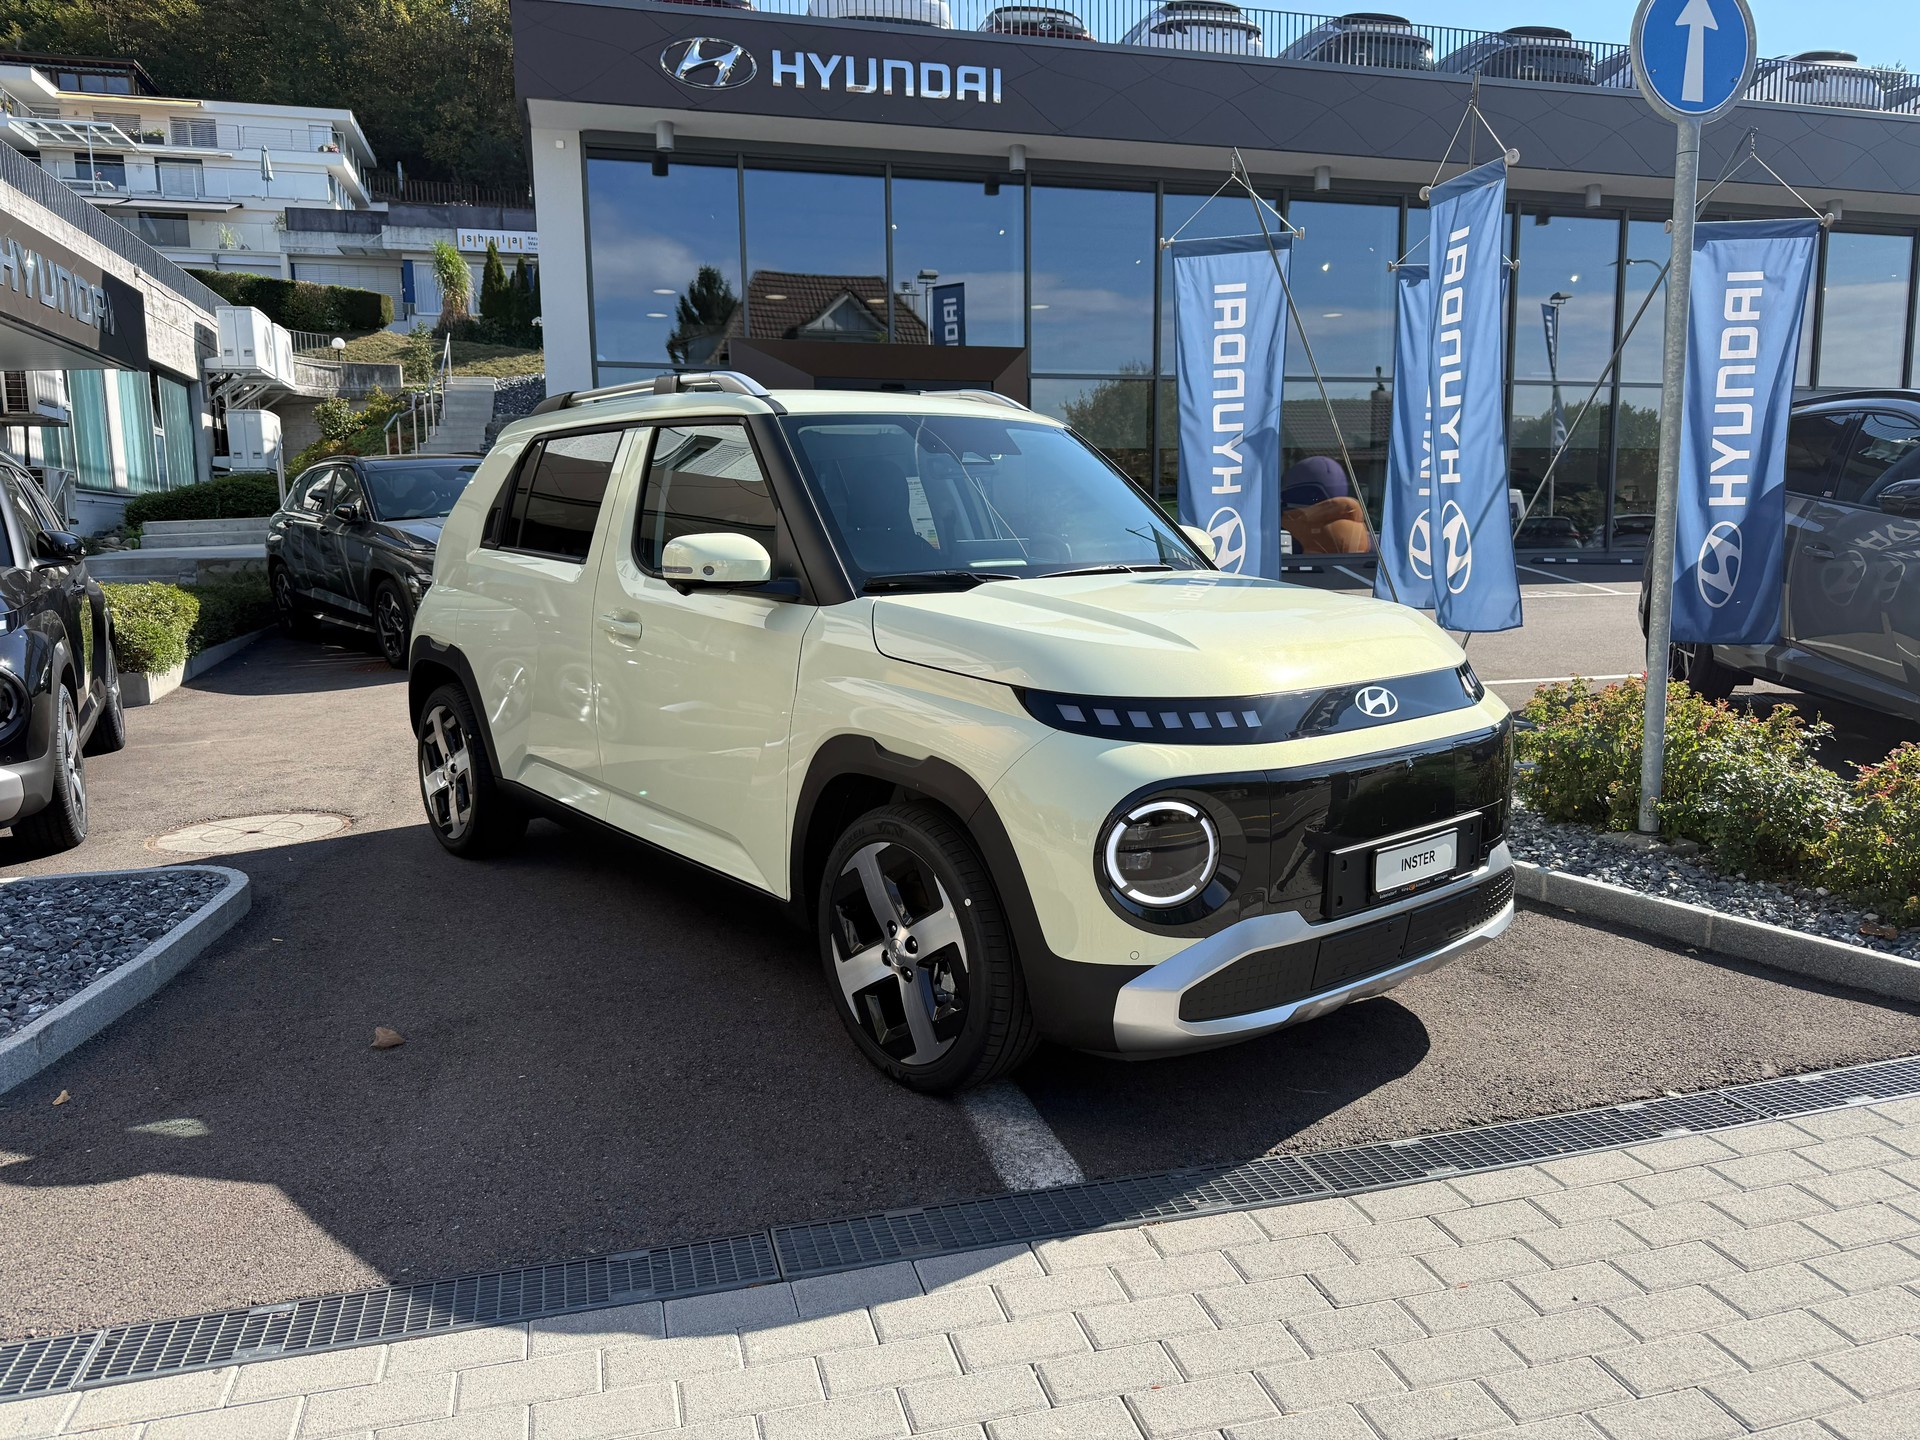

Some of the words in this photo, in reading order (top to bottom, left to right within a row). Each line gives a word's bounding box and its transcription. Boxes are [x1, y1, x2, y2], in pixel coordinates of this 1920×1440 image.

[772, 49, 1002, 103] HYUNDAI
[0, 236, 115, 336] HYUNDAI
[1708, 271, 1764, 506] HYUNDAI
[1401, 850, 1435, 871] INSTER
